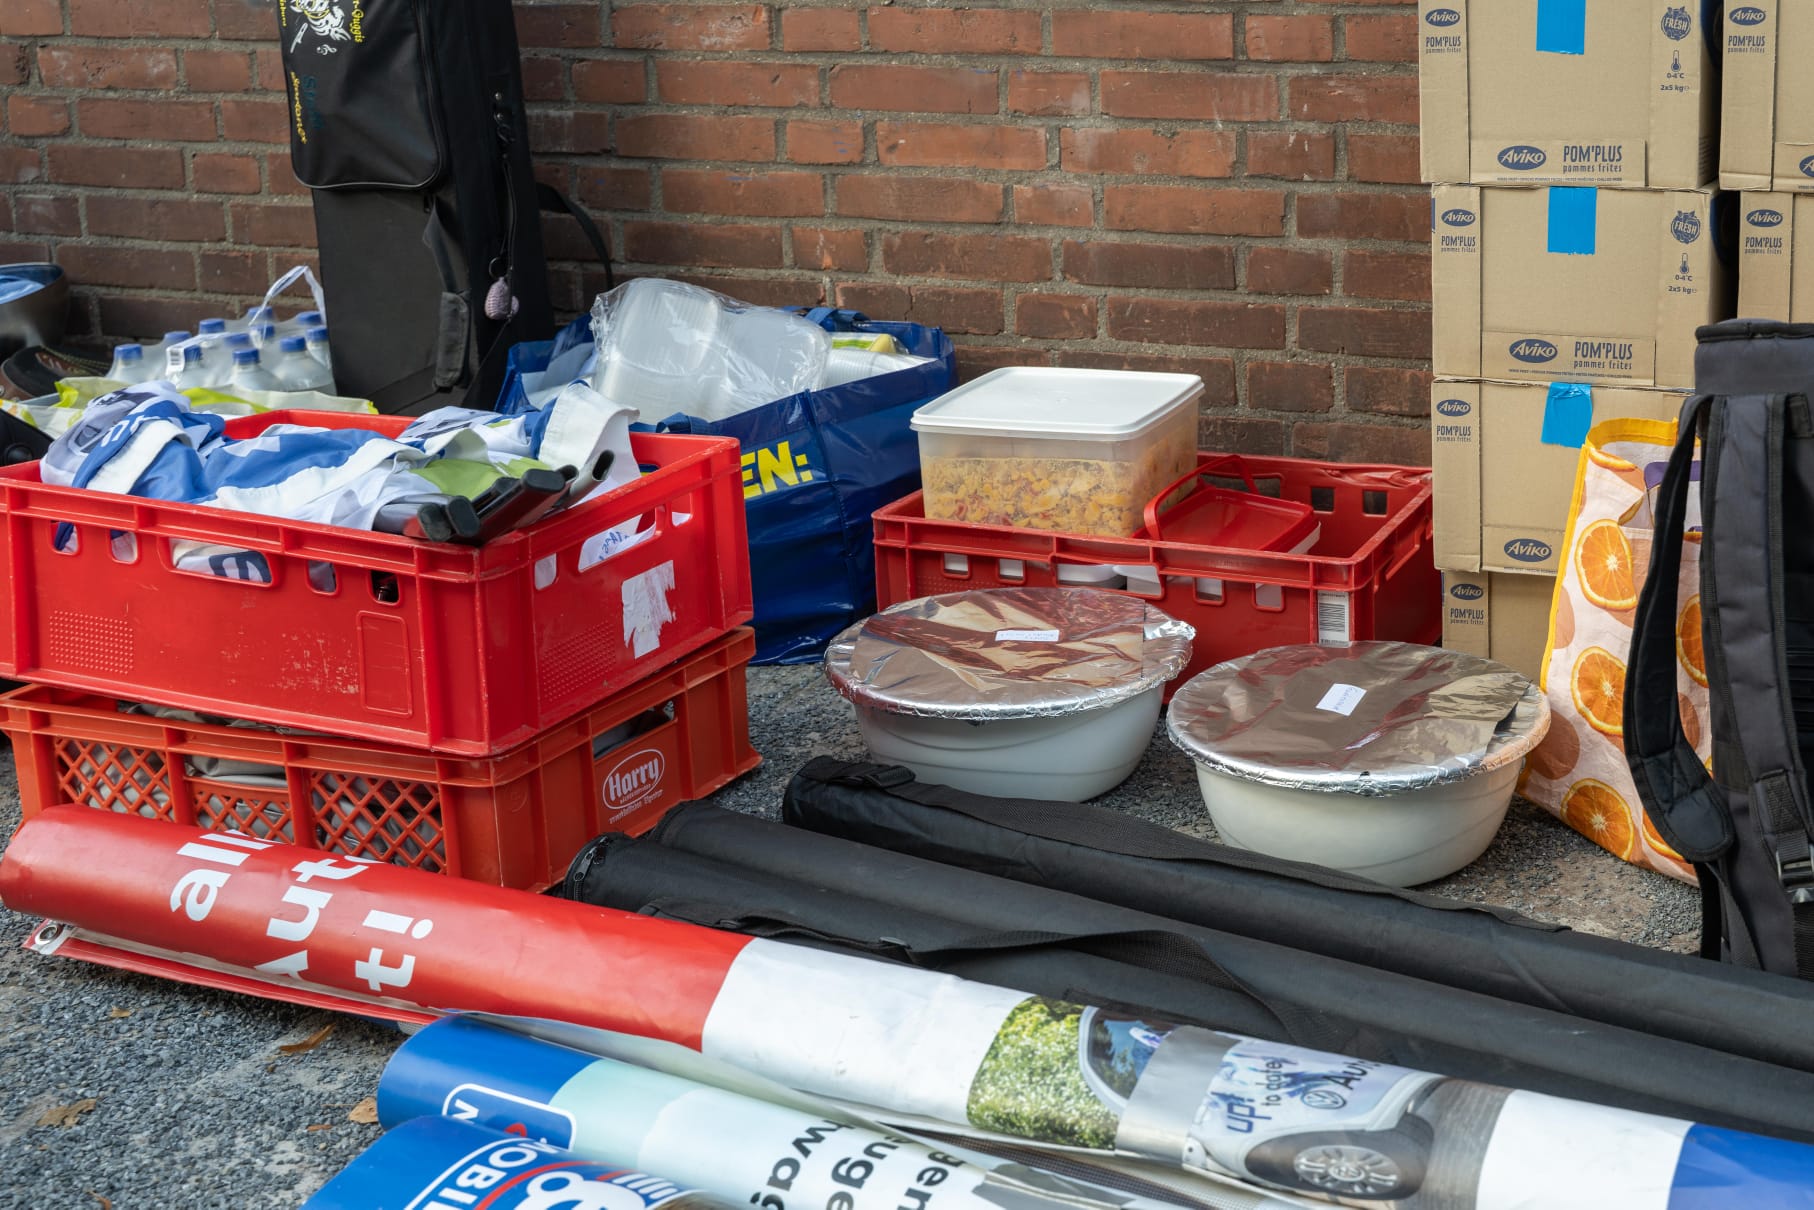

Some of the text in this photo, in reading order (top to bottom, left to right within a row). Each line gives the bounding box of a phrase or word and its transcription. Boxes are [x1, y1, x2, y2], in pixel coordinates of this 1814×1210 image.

[1427, 11, 1460, 22] Aviko
[1731, 10, 1764, 21] Aviko
[1664, 17, 1688, 31] FRESH
[1425, 36, 1461, 47] POM'PLUS
[1728, 35, 1766, 47] POM'PLUS
[1500, 149, 1544, 165] Aviko
[1563, 145, 1623, 162] POM'PLUS
[1563, 163, 1622, 174] pommes frites
[1443, 212, 1474, 223] Aviko
[1749, 211, 1782, 224] Aviko
[1674, 221, 1698, 235] FRESH
[1441, 235, 1476, 247] POM'PLUS
[1745, 237, 1782, 248] POM'PLUS
[1511, 341, 1556, 358] Aviko
[1574, 341, 1633, 360] POM'PLUS
[1574, 360, 1632, 370] pommes frites
[1439, 402, 1470, 413] Aviko
[1436, 425, 1472, 436] POM'PLUS
[740, 440, 814, 500] EN:
[1506, 541, 1550, 558] Aviko
[1453, 585, 1482, 597] Aviko
[1450, 607, 1484, 619] POM'PLUS
[608, 757, 660, 802] Harry
[355, 909, 434, 992] t!
[1260, 1093, 1283, 1107] to
[1210, 1091, 1273, 1134] up!
